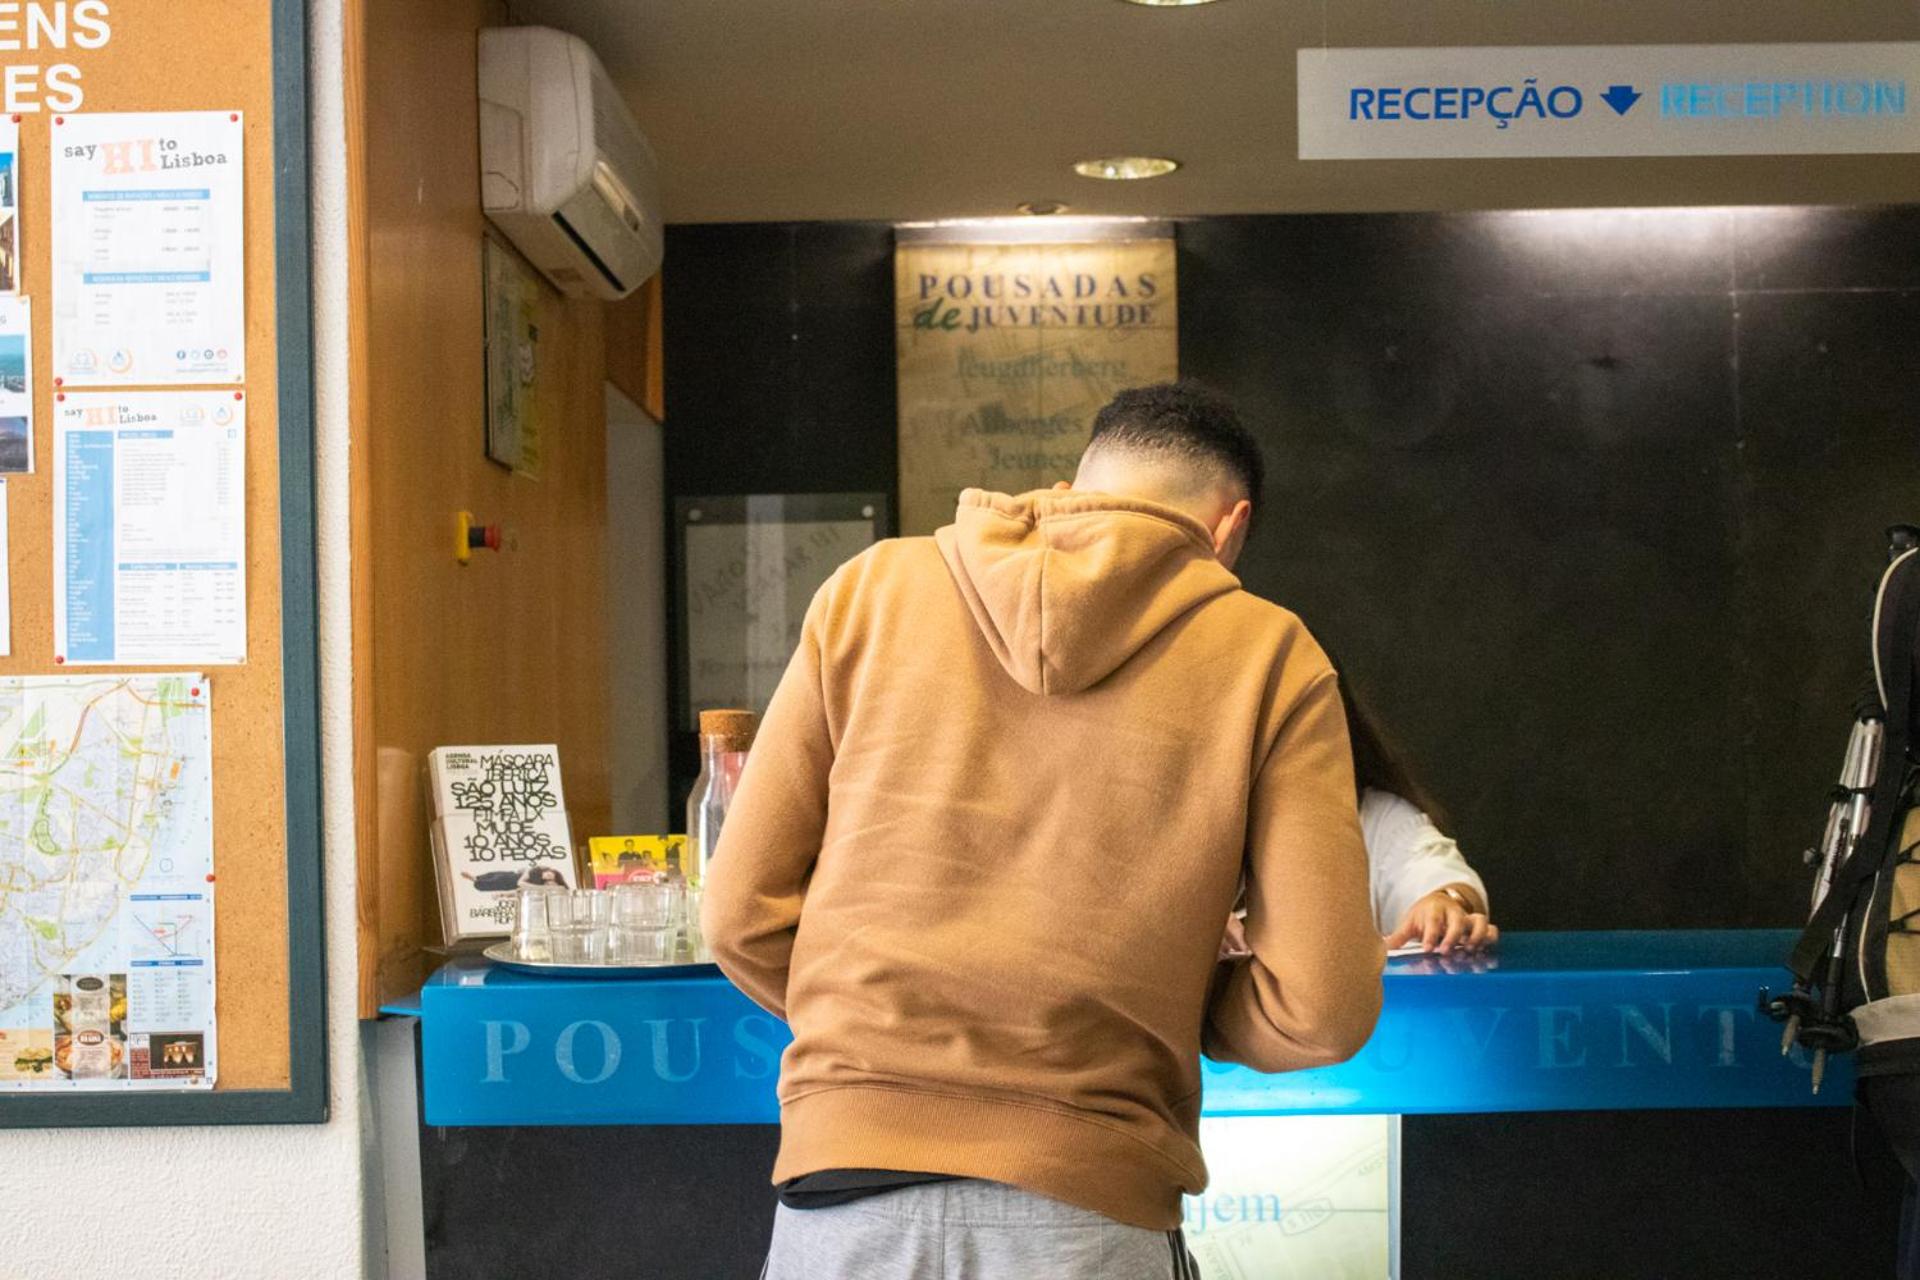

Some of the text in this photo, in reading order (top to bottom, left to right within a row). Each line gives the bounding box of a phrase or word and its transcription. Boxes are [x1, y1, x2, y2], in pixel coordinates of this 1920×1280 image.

[0, 0, 112, 50] ENS
[4, 64, 85, 113] ES
[1348, 77, 1907, 129] RECEPÇÃO RECEPTION
[159, 137, 178, 152] to
[64, 137, 157, 175] say HI
[160, 152, 228, 171] Lisboa
[918, 272, 1158, 300] POUSADAS
[913, 297, 1156, 333] de JUVENTUDE
[119, 414, 158, 424] Lisboa
[450, 777, 549, 797] SÃO LUIZ
[499, 793, 558, 809] ANOS
[476, 821, 536, 835] MUDE
[464, 833, 552, 849] 10 ANOS
[469, 846, 568, 867] 10 PEÇAS
[478, 1003, 1824, 1085] POUS UVENT
